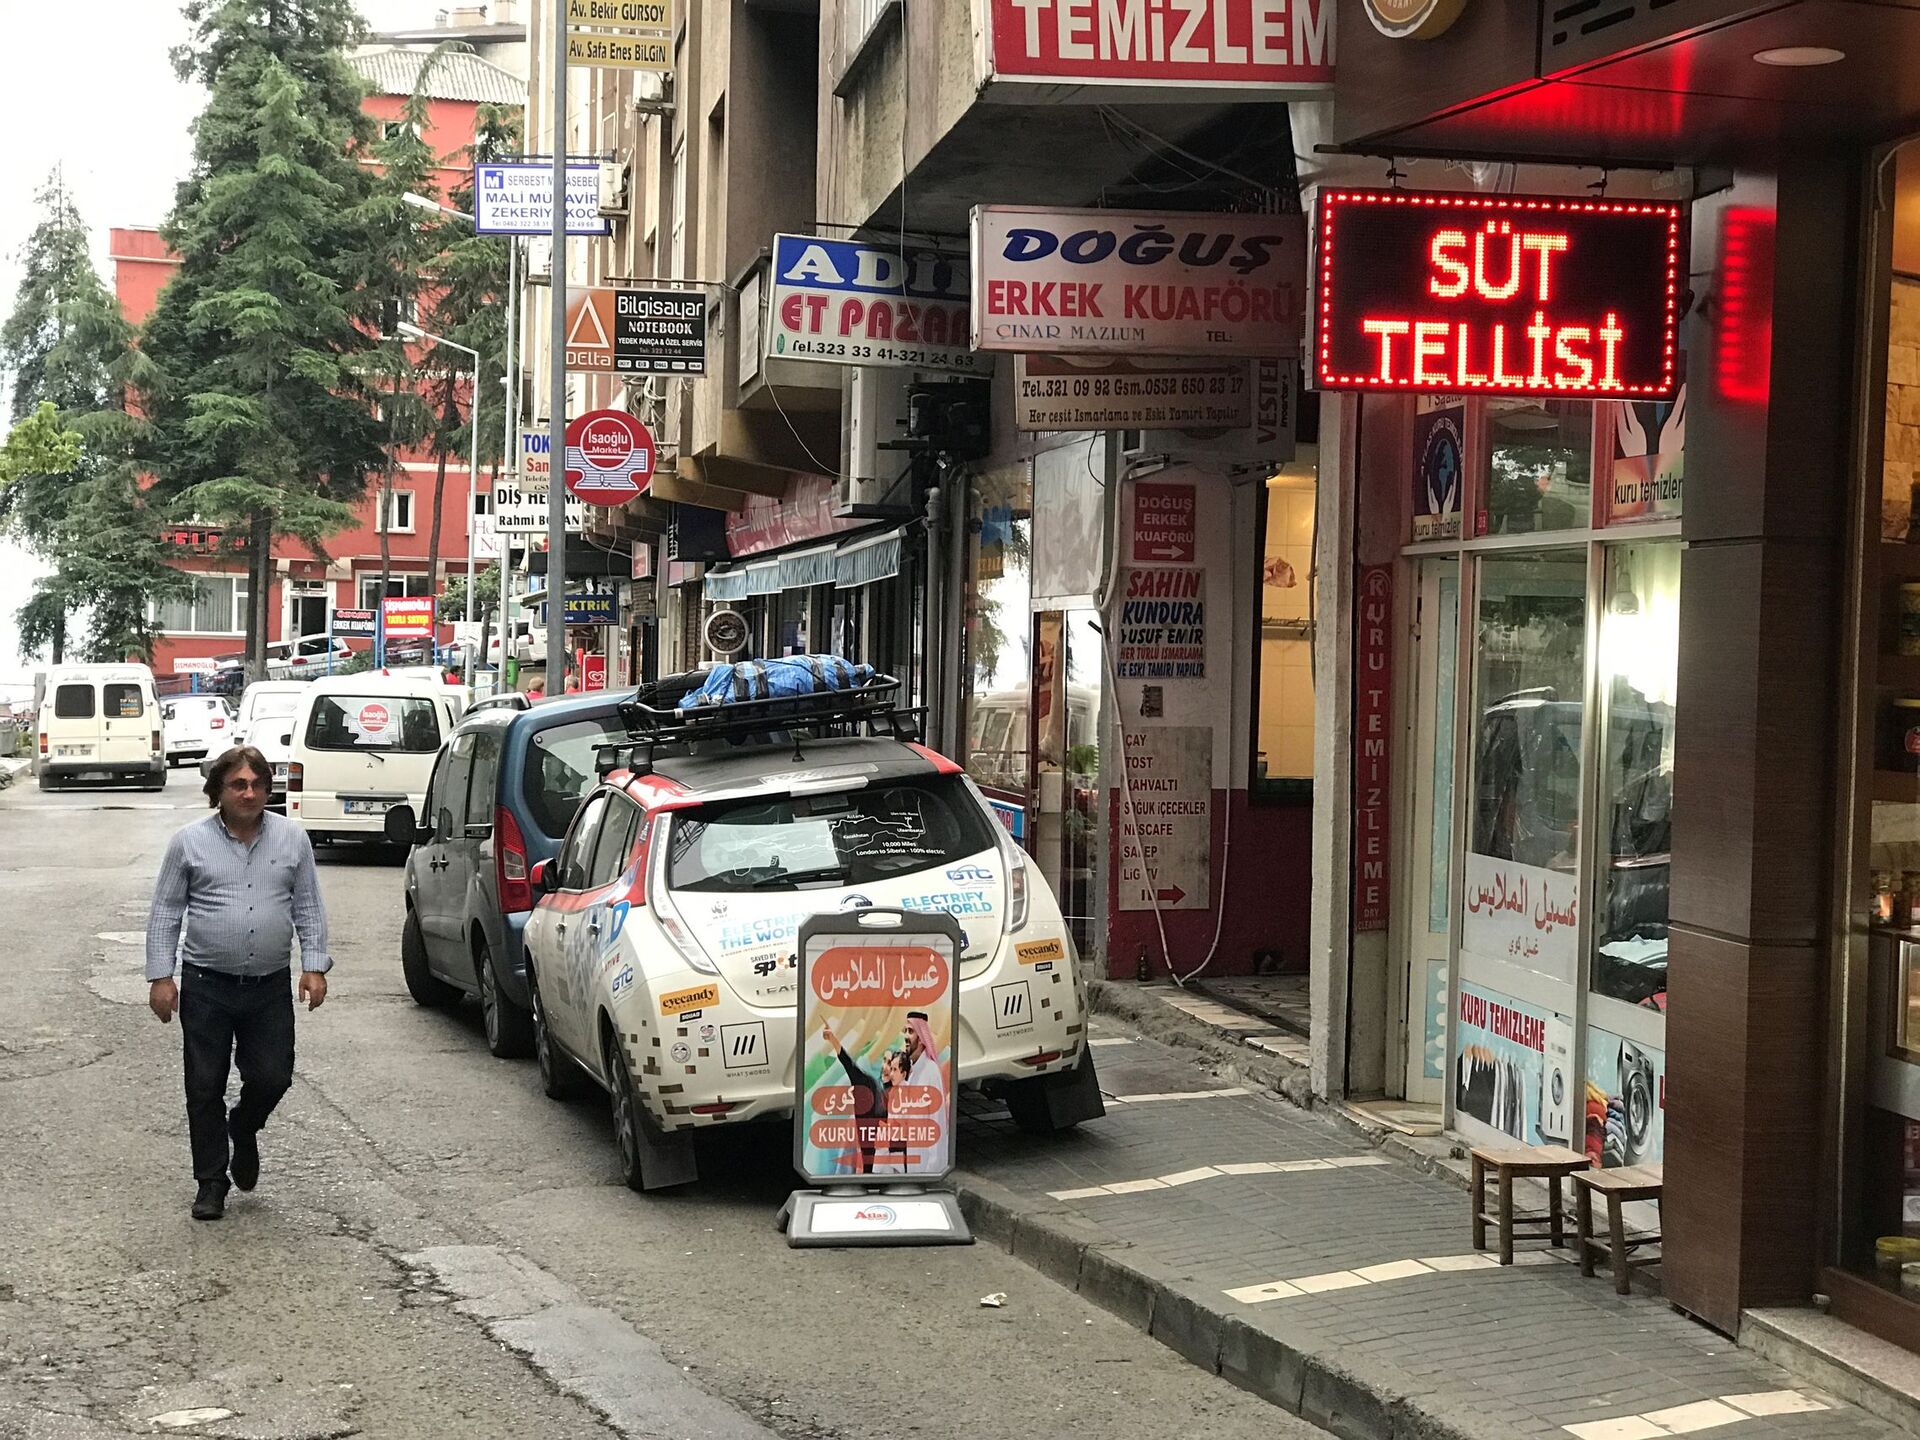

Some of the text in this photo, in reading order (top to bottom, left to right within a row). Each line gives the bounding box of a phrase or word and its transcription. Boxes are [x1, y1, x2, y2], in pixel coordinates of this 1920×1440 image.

[570, 0, 587, 17] Av.
[590, 2, 618, 19] Bekir
[1012, 0, 1336, 66] TEMiZLEM
[569, 40, 584, 57] Av.
[587, 41, 607, 59] Safa
[610, 43, 632, 60] Enes
[508, 175, 545, 186] SERBEST
[486, 191, 524, 204] MALİ
[1002, 224, 1284, 275] DOĞUŞ
[1429, 220, 1569, 301] SÜT
[617, 296, 703, 319] Bilgisayar
[987, 279, 1296, 324] ERKEK KUAFÖRÜ
[780, 293, 829, 334] ET
[628, 321, 693, 335] NOTEBOOK
[1071, 325, 1145, 341] MAZLUM
[617, 337, 638, 345] YEDEK
[638, 337, 659, 347] PARÇA
[665, 338, 681, 347] ÖZEL
[852, 345, 871, 357] 33
[954, 354, 974, 366] 63
[1022, 379, 1068, 397] Tel.321
[1073, 379, 1090, 397] 09
[1094, 378, 1110, 396] 92
[1181, 377, 1205, 394] 650
[1209, 377, 1226, 394] 23
[1230, 377, 1244, 394] 17
[1028, 409, 1046, 423] Her
[1050, 408, 1072, 425] çeşit
[523, 434, 550, 453] TOK
[588, 428, 628, 447] İsaoğlu
[592, 446, 621, 454] Market
[526, 457, 549, 472] San
[497, 484, 522, 508] DİŞ
[1614, 479, 1637, 505] kuru
[1138, 495, 1193, 513] DOĞUŞ
[499, 514, 535, 526] Rahmi
[1143, 513, 1187, 526] ERKEK
[1135, 529, 1194, 543] KUAFÖRÜ
[1121, 600, 1204, 627] KUNDURA
[1120, 647, 1135, 660] HER
[1117, 663, 1127, 676] VE
[1125, 734, 1147, 751] ÇAY
[1125, 756, 1153, 769] TOST
[901, 891, 984, 909] ELECTRIFY
[718, 935, 753, 950] THE
[1018, 942, 1060, 958] eyecandy
[750, 952, 777, 963] SAVED BY
[820, 952, 940, 1000] غسيل الملابس
[662, 988, 715, 1009] eyecandy
[1460, 991, 1546, 1054] KURU TEMIZLEME
[891, 1085, 933, 1116] غسيل
[818, 1124, 936, 1143] KURU TEMİZLEME
